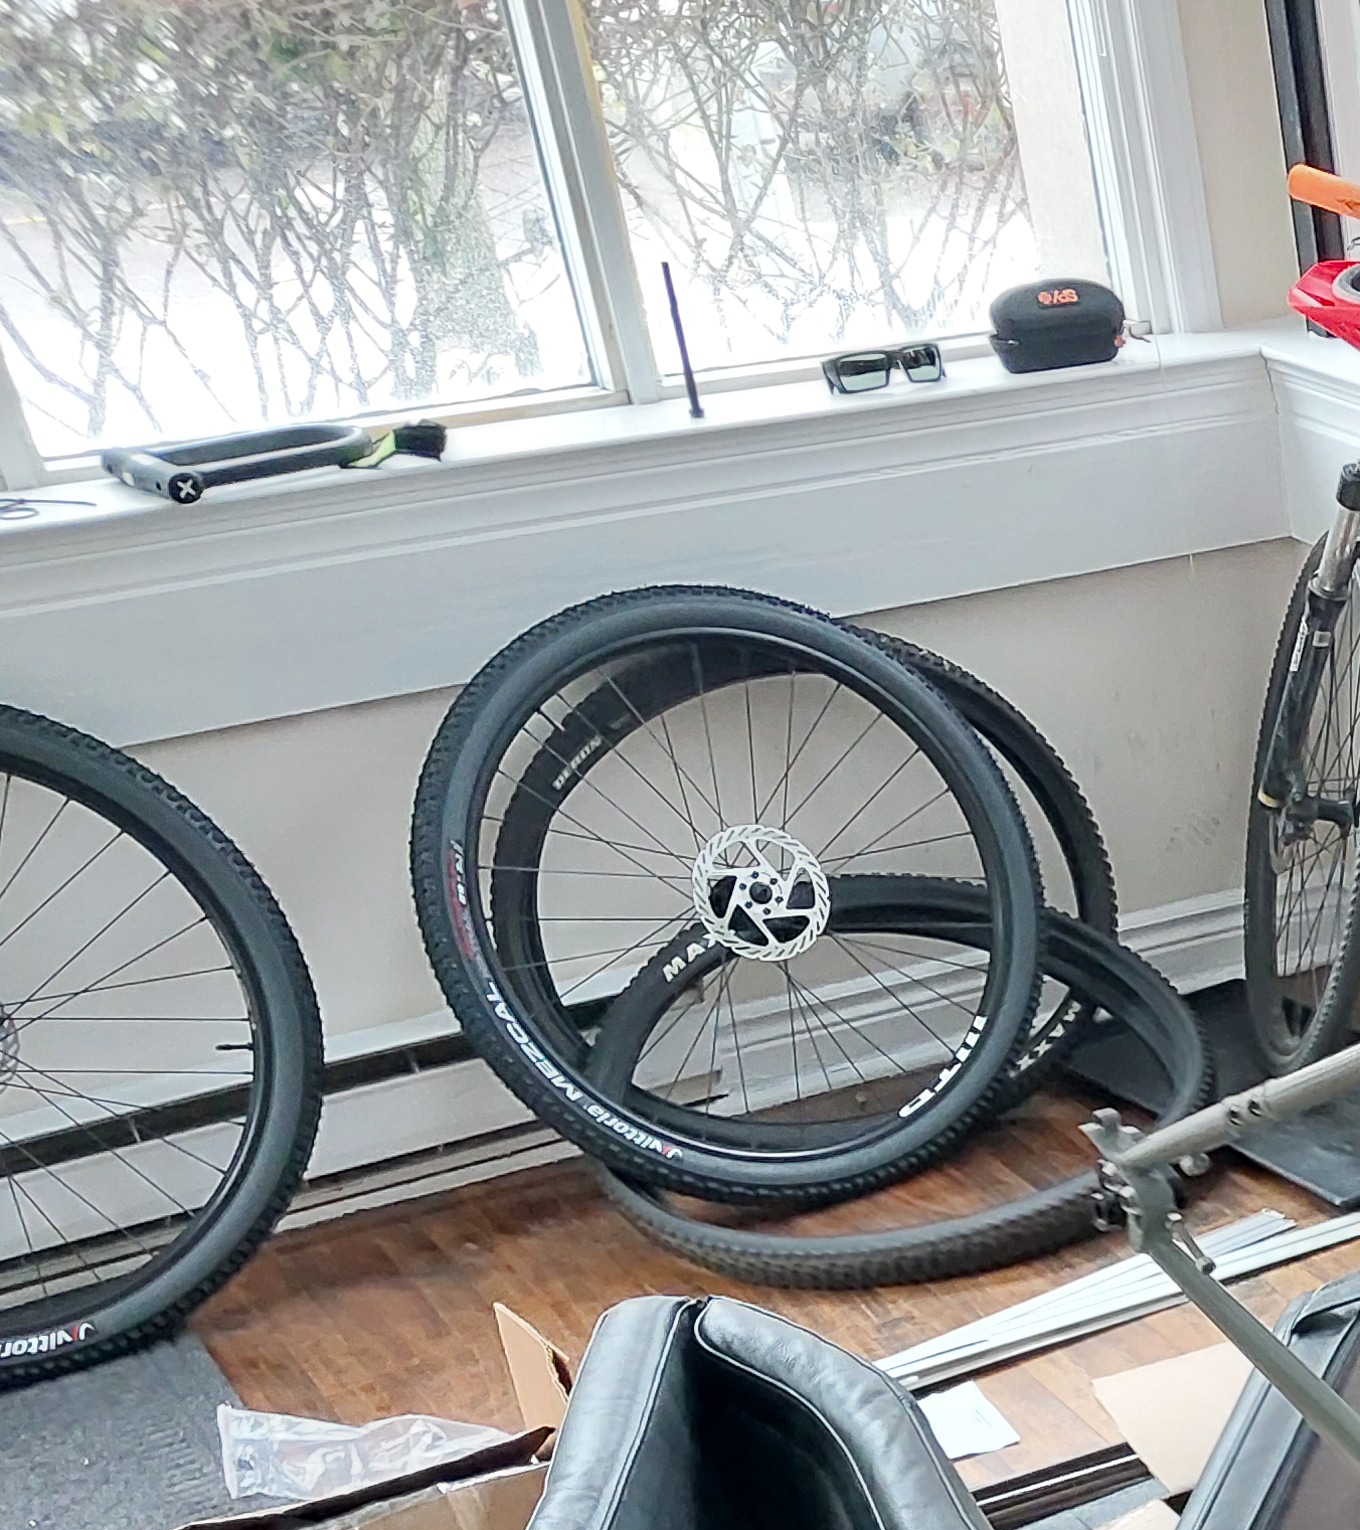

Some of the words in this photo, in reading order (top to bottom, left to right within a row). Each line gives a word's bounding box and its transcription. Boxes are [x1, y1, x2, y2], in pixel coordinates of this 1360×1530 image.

[1053, 289, 1078, 303] SPY
[487, 982, 583, 1102] MEZCAL
[0, 1330, 72, 1358] vittor
